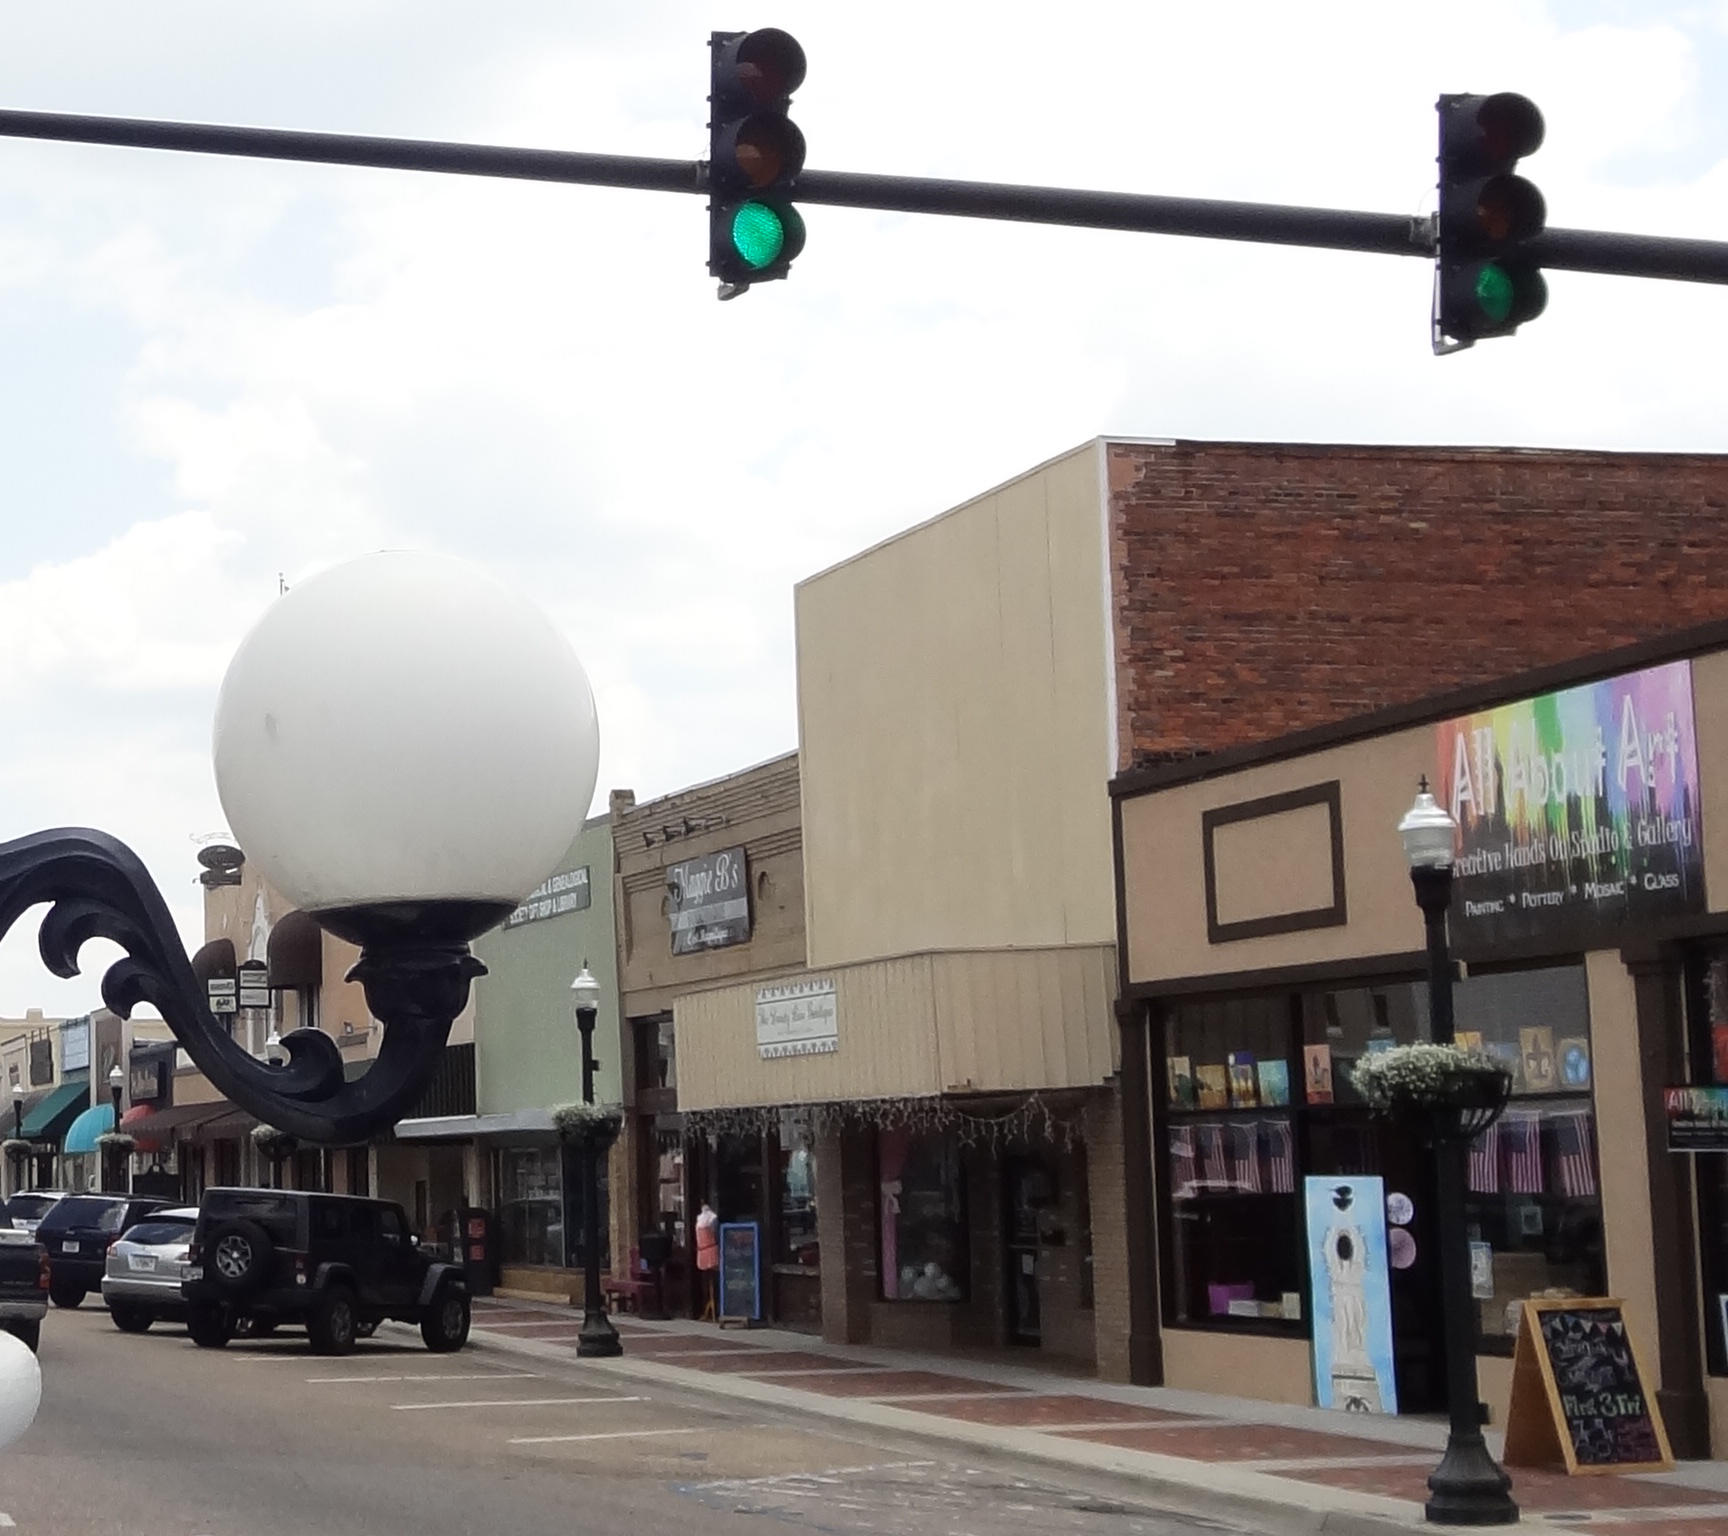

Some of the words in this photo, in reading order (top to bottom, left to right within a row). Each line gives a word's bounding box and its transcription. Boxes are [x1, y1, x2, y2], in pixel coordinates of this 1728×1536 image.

[1451, 727, 1496, 823] All
[1506, 724, 1605, 808] About
[1617, 694, 1679, 792] Art
[714, 851, 738, 893] B's
[1452, 847, 1502, 879] reative
[1504, 839, 1547, 870] Hands
[1637, 814, 1692, 847] Gallery
[1522, 891, 1565, 909] POTTERY
[1584, 880, 1625, 901] MOSAIC
[1644, 872, 1680, 891] GLASS
